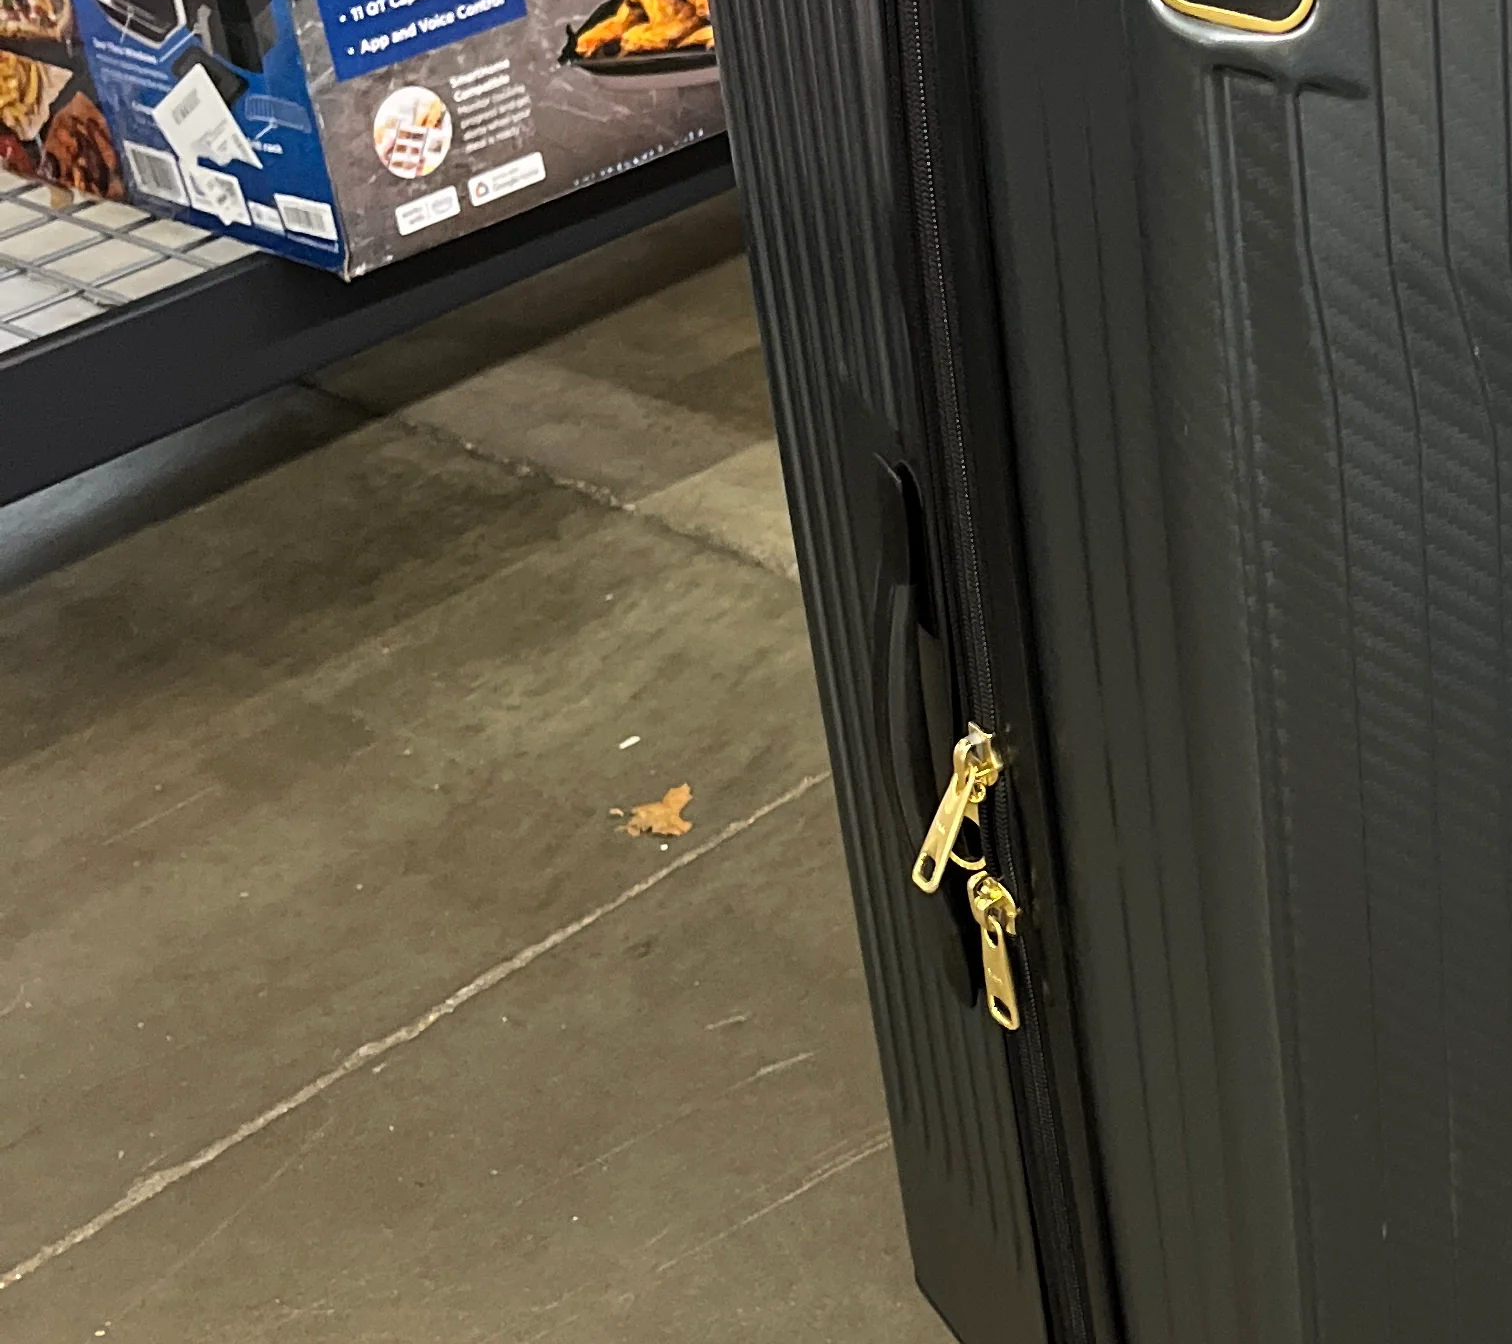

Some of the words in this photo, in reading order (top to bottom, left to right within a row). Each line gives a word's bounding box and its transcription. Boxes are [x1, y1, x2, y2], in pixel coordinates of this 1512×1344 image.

[350, 5, 365, 22] 11
[360, 33, 390, 56] App
[391, 21, 418, 44] and
[417, 10, 456, 34] Voice
